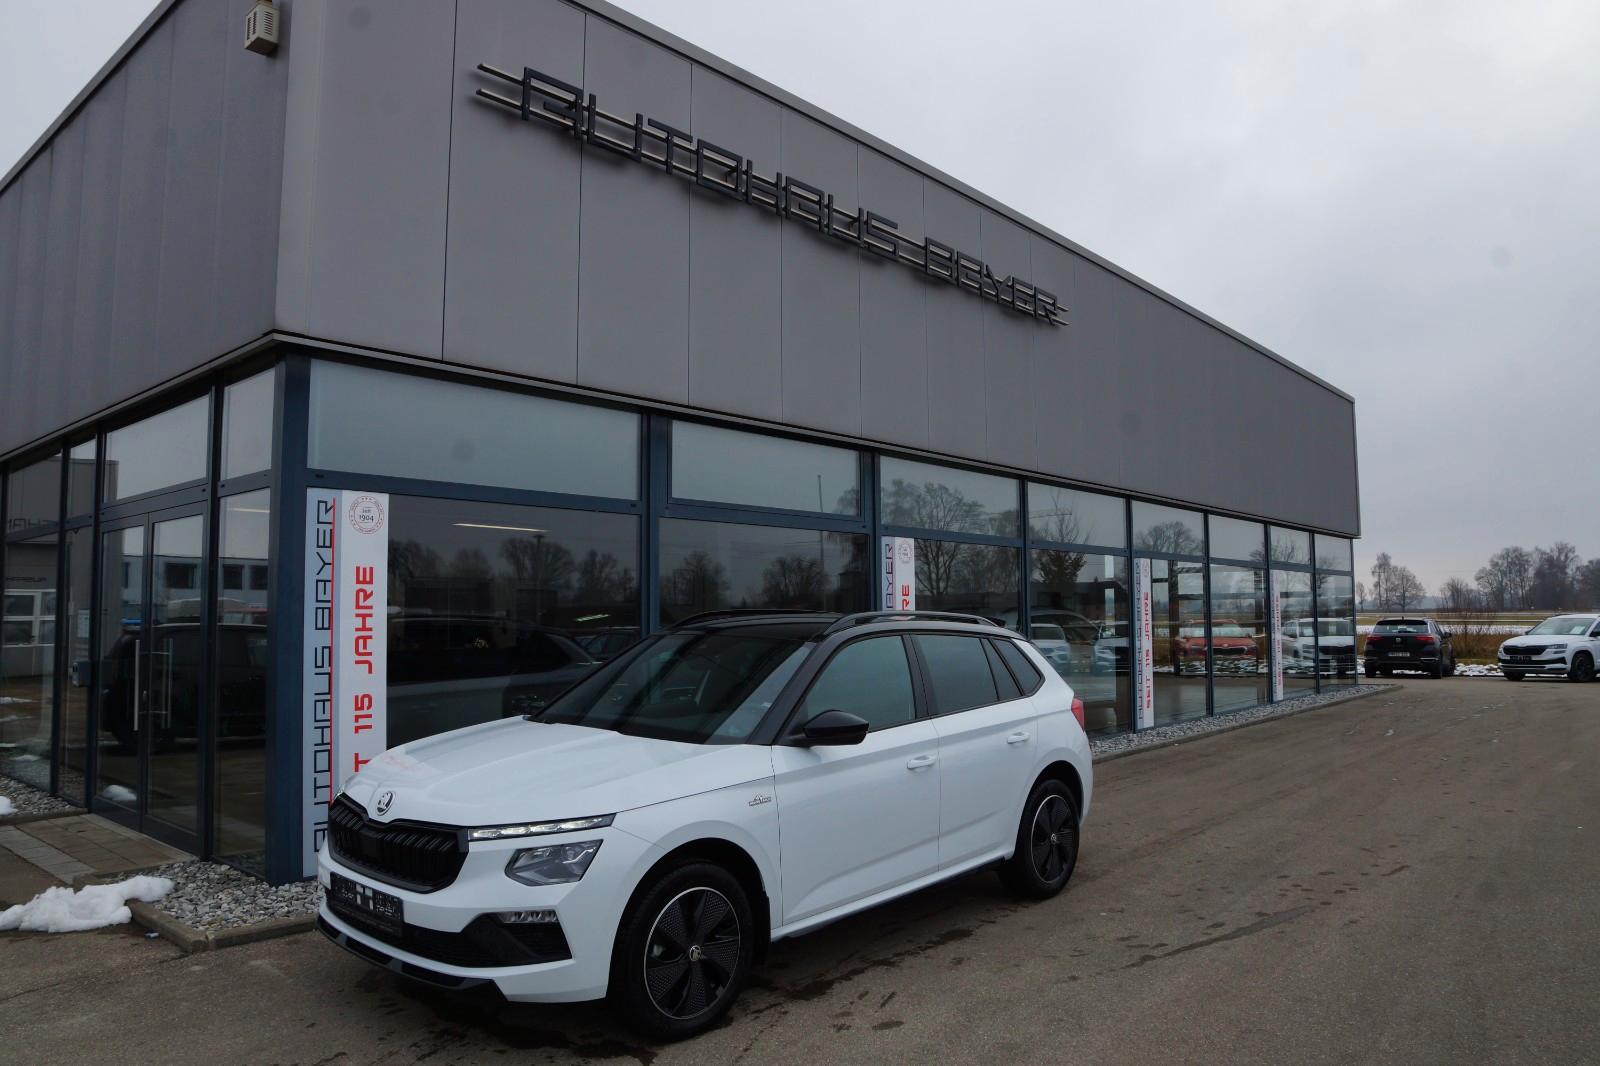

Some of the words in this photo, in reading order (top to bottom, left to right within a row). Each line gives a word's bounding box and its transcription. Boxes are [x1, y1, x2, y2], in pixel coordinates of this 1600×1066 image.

[521, 66, 898, 258] AUTOHAUS
[925, 237, 1058, 326] BAYER
[314, 499, 335, 631] BAYER
[359, 514, 374, 523] 1904
[354, 565, 375, 675] JAHRE
[885, 544, 893, 607] AYER
[313, 645, 332, 853] AUTOHAUS
[354, 693, 373, 735] 115
